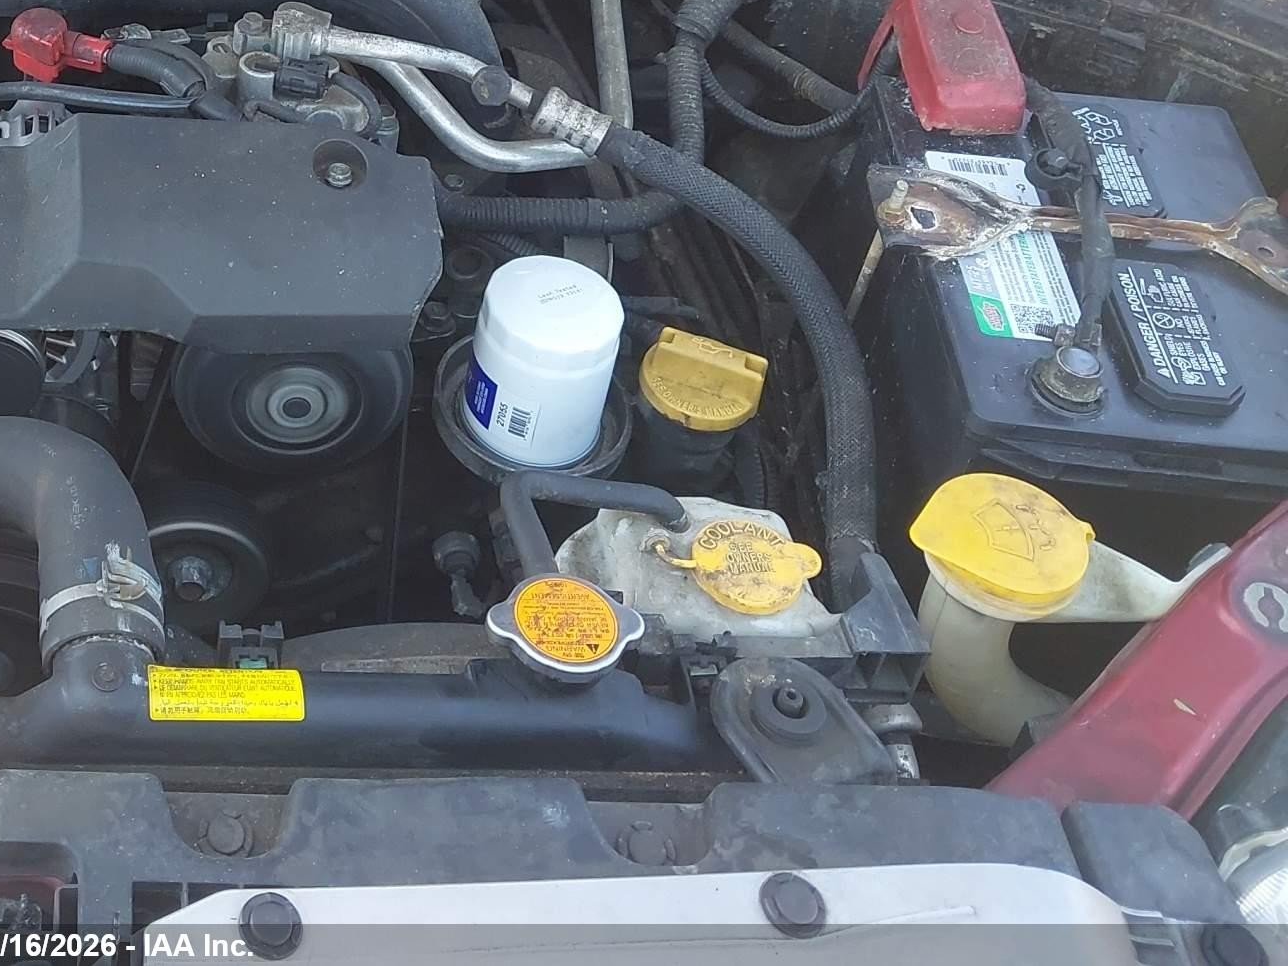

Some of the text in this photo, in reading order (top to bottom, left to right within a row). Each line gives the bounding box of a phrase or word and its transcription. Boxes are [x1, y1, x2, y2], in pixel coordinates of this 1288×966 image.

[1117, 273, 1143, 311] POISON
[1137, 322, 1166, 366] DANGER
[496, 401, 509, 428] 27055
[698, 521, 786, 550] COOLANT
[728, 542, 753, 553] SEE
[726, 552, 773, 563] OWNERS
[545, 645, 586, 653] WARNING
